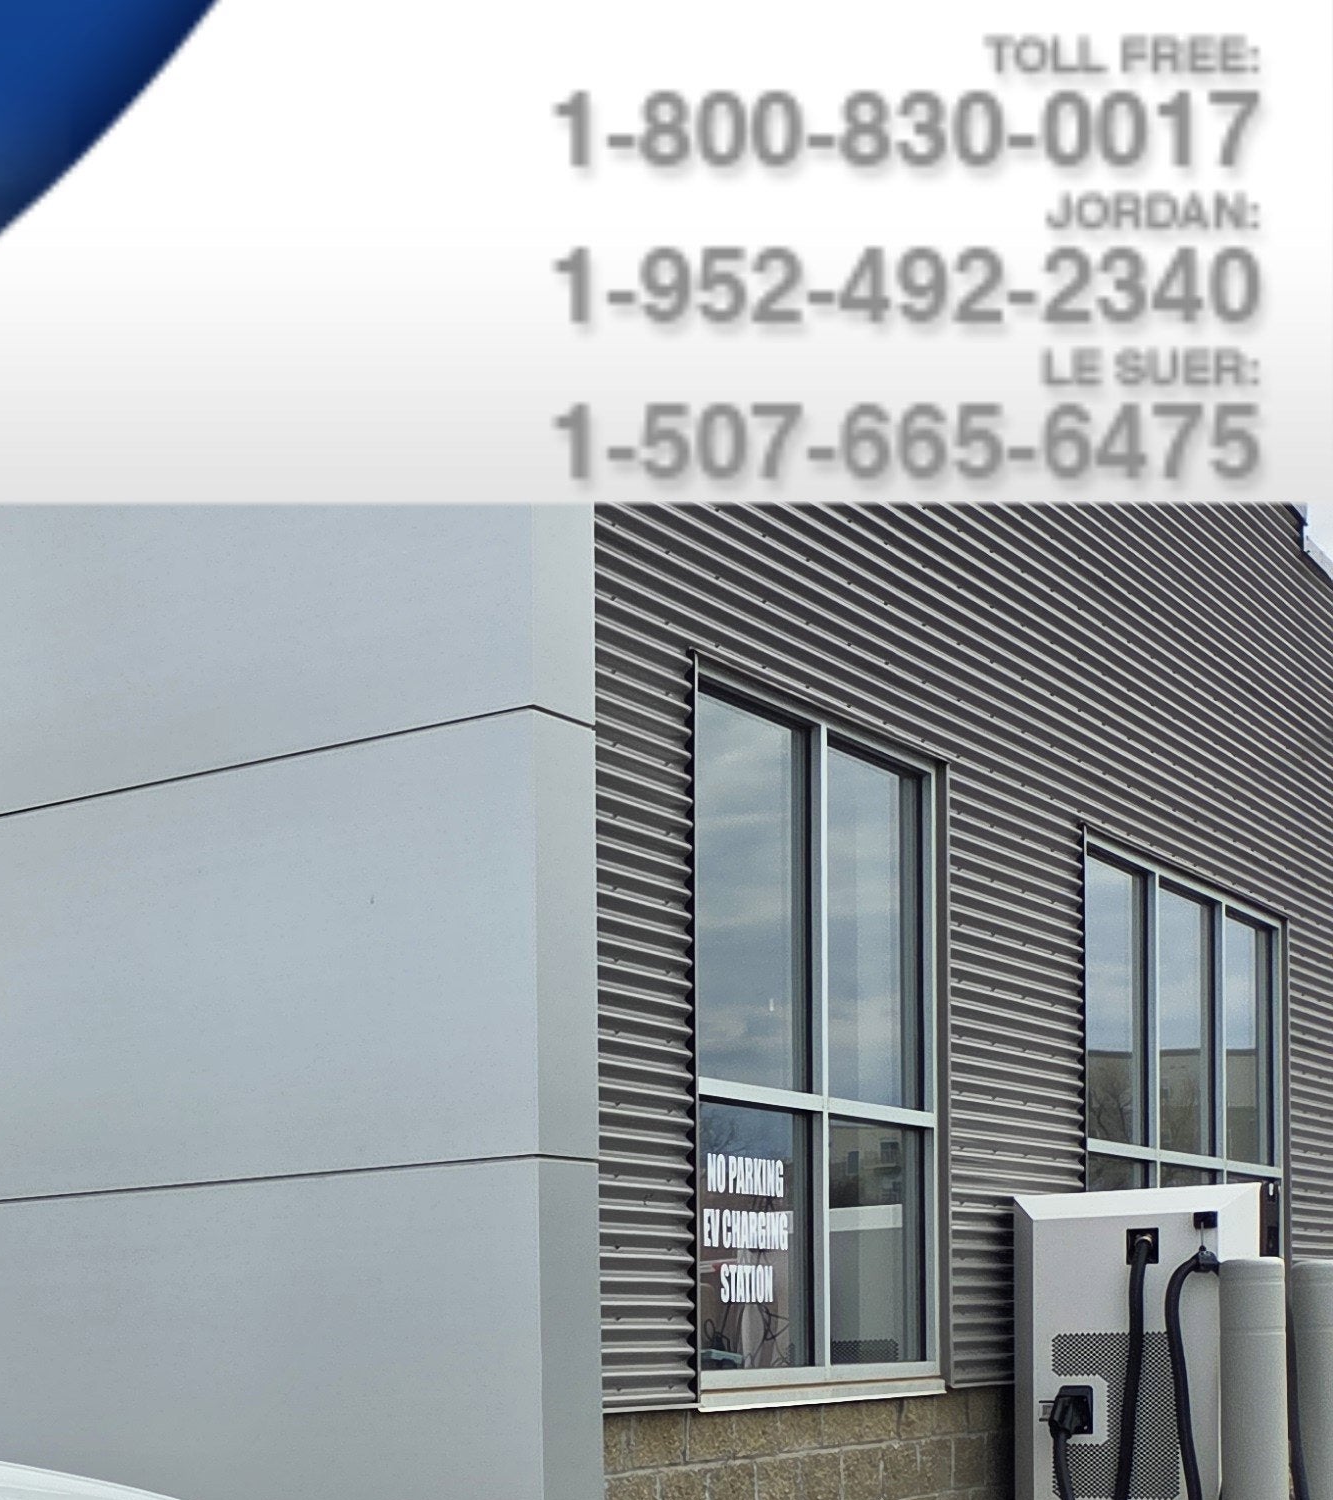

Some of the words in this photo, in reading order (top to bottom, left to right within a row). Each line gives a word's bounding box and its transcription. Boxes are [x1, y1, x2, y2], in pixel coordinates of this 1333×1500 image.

[706, 1152, 727, 1194] NO
[728, 1155, 784, 1198] PARKING
[703, 1208, 721, 1248] EV
[722, 1209, 789, 1251] CHARGING
[720, 1263, 774, 1304] STATION
